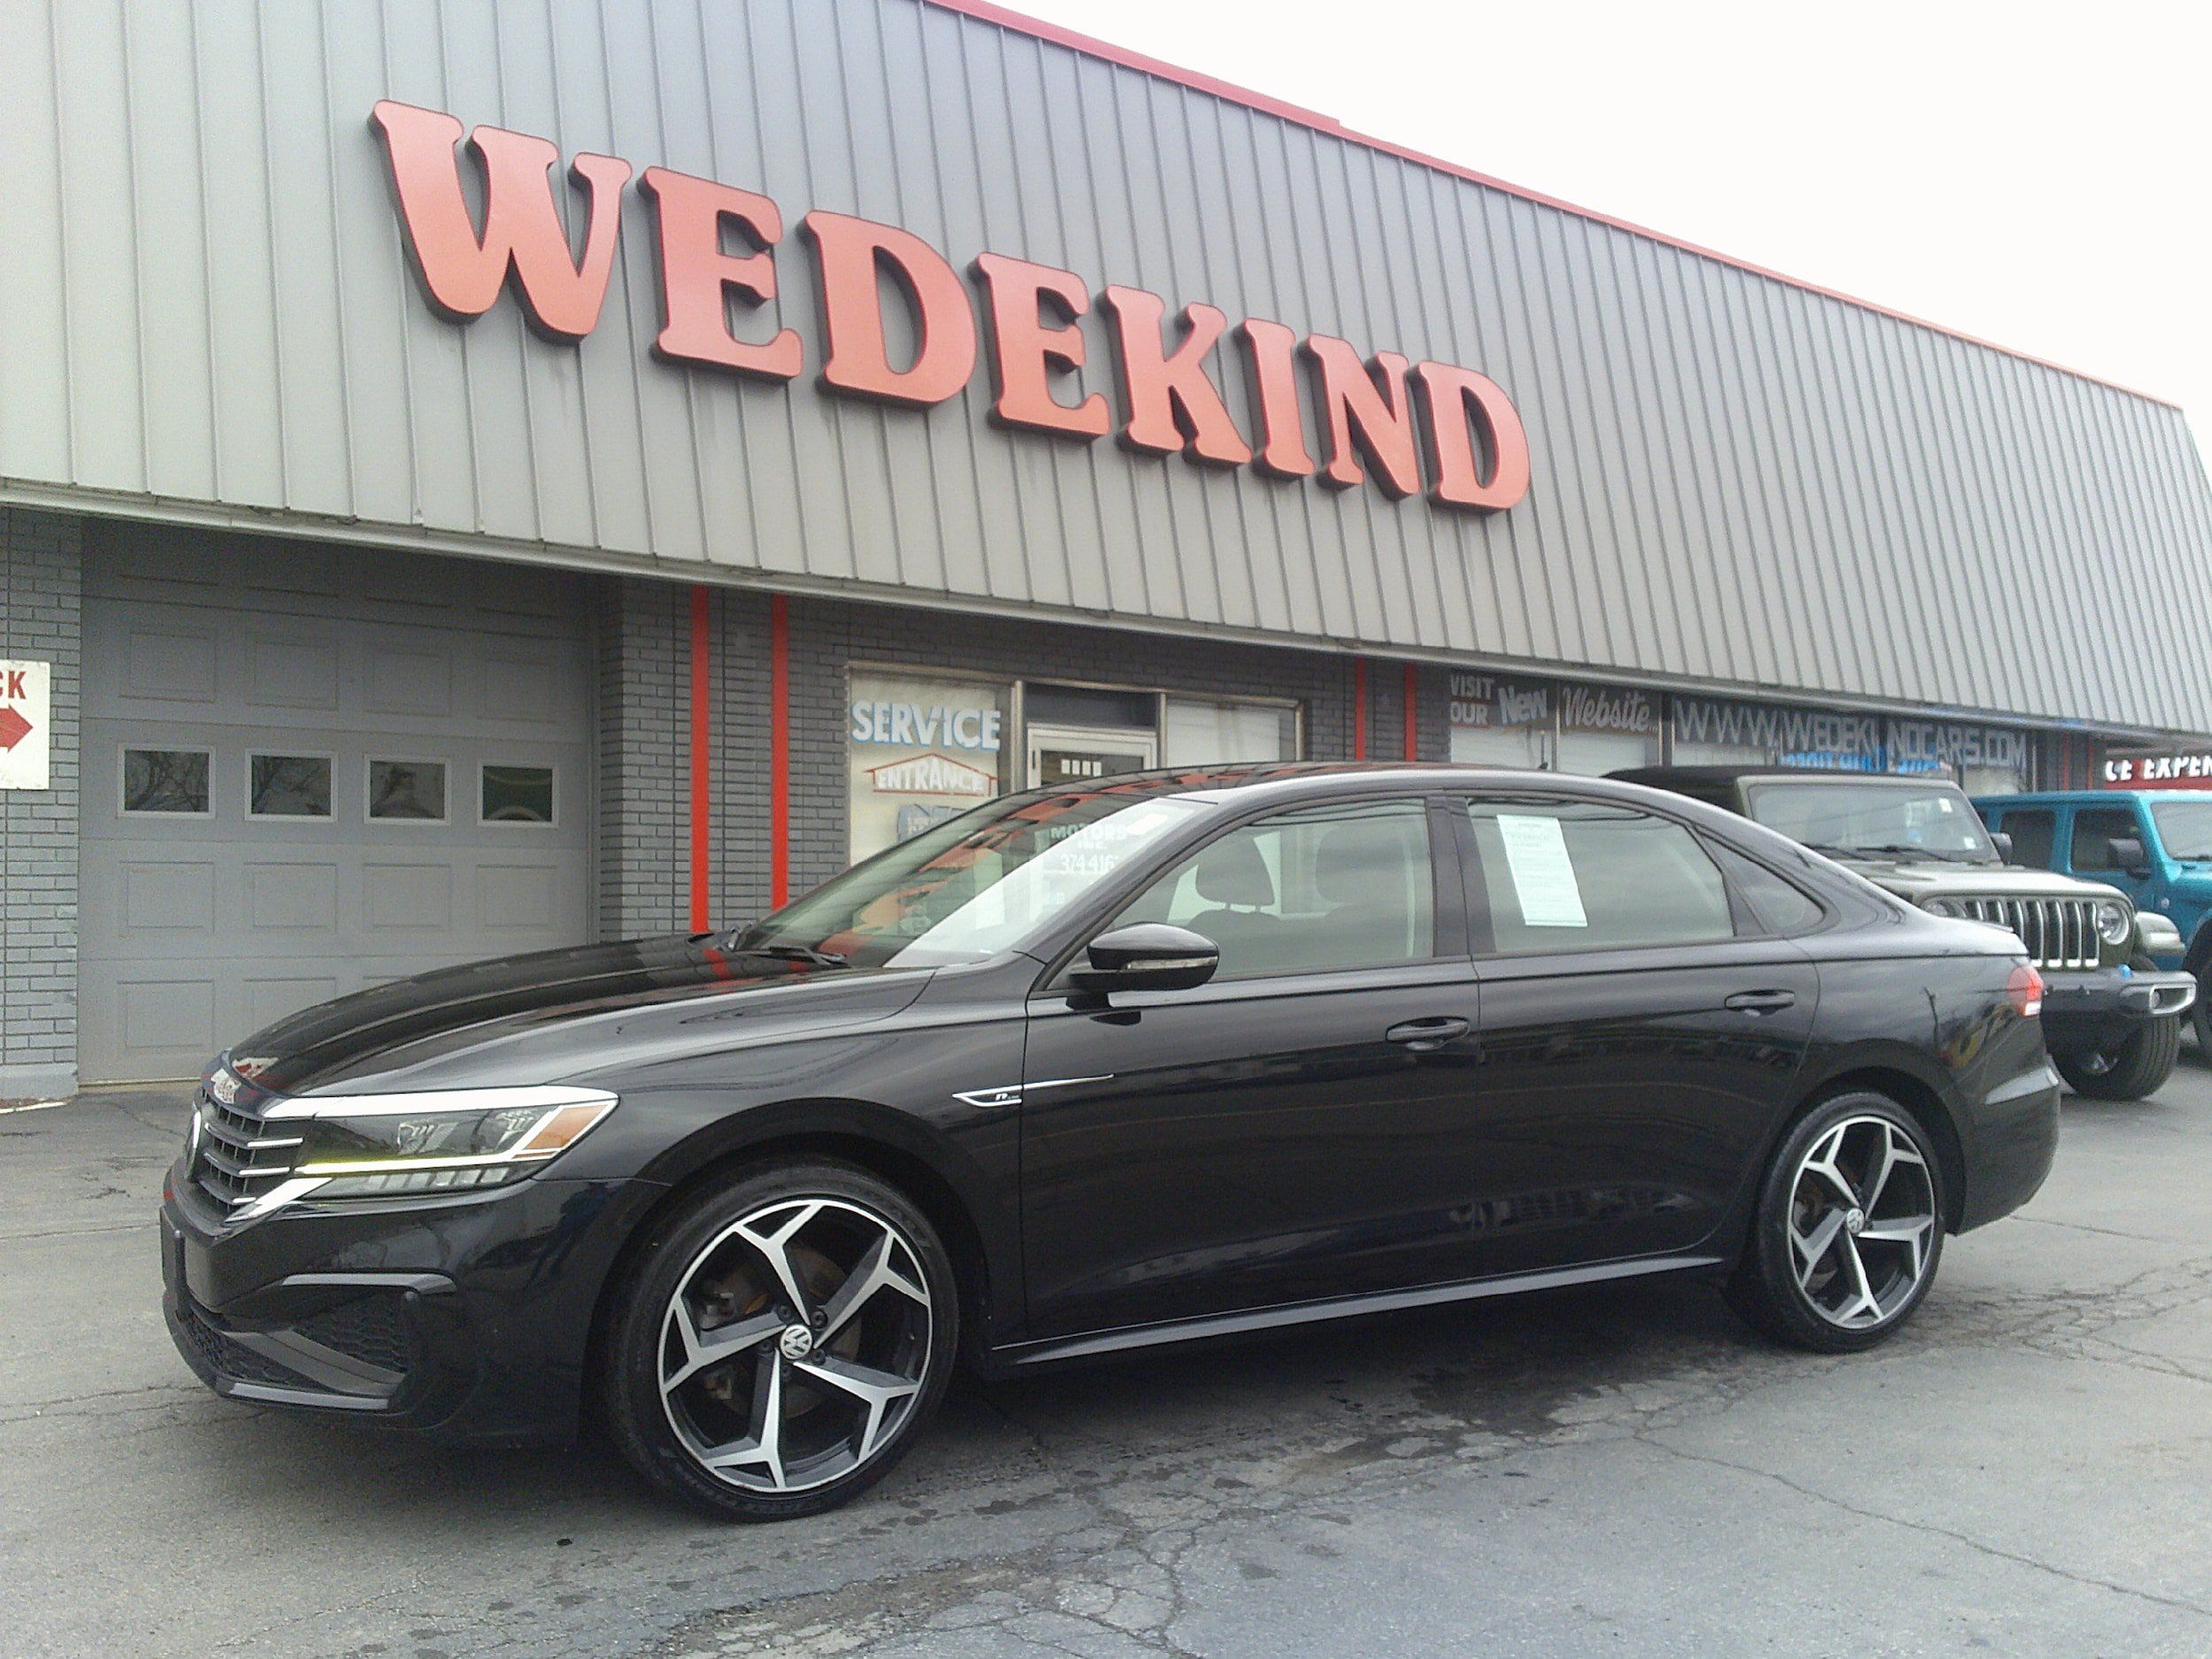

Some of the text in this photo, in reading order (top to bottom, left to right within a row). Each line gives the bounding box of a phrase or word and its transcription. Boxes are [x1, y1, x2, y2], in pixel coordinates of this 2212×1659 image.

[370, 100, 1532, 513] WEDEKIND
[1450, 675, 1495, 700] VISIT
[851, 701, 1002, 751] SERVICE
[1450, 701, 1488, 724] OUR
[878, 757, 985, 791] ENTRANCE
